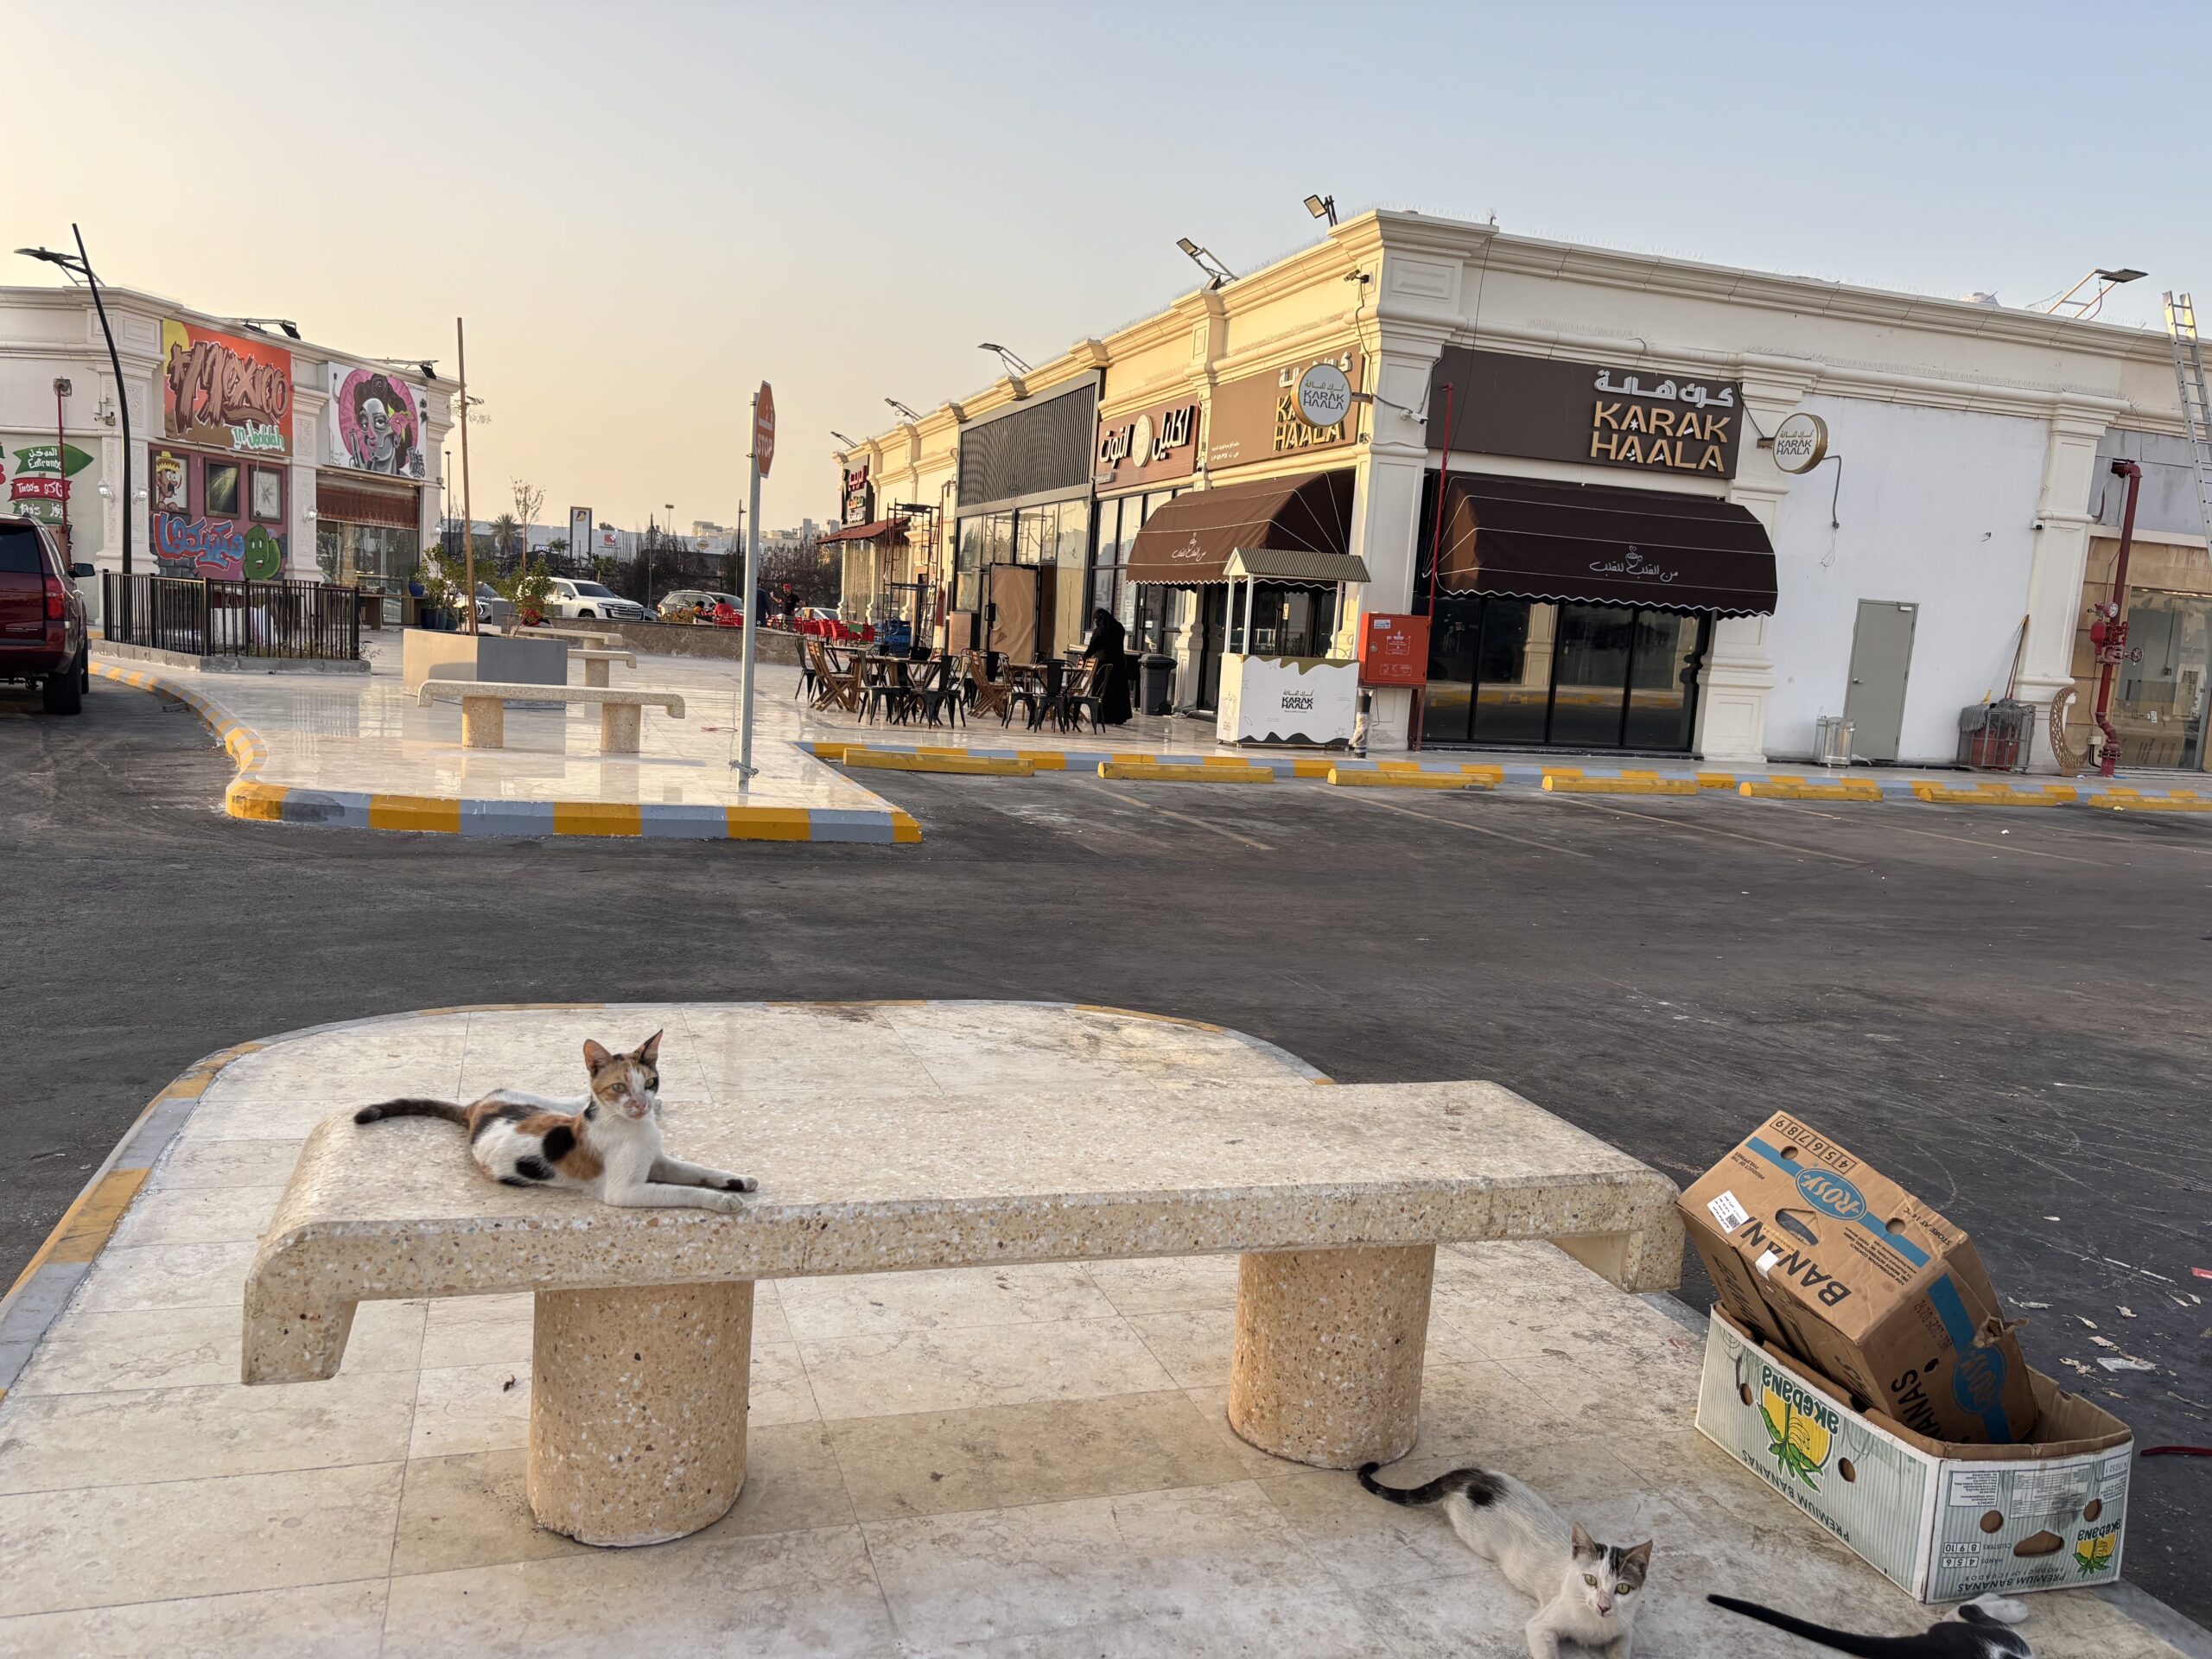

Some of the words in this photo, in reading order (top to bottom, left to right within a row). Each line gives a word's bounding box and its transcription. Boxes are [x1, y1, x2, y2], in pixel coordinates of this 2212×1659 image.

[167, 340, 289, 435] Mexico
[1593, 369, 1678, 401] هالة
[1303, 398, 1344, 410] HAALA
[1304, 390, 1344, 403] KARAK
[1678, 383, 1734, 409] كرك
[1593, 400, 1732, 443] KARAK
[1152, 404, 1193, 461] اكليل
[757, 433, 773, 458] STOP
[1099, 424, 1134, 469] التوت
[1590, 431, 1725, 473] HAALA
[1589, 561, 1624, 577] للقلب
[1626, 563, 1659, 580] القلب
[1660, 571, 1679, 582] من
[1787, 1127, 1798, 1135] 8
[1798, 1135, 1810, 1143] 7
[1735, 1152, 1759, 1170] PHILIPPINES
[1825, 1151, 1837, 1160] 5
[1745, 1164, 1765, 1180] PRODUCT
[1801, 1176, 1861, 1214] ROSY
[1929, 1228, 1952, 1246] STORE
[1740, 1217, 1852, 1307] BANAN
[1743, 1450, 1796, 1499] BANANAS
[1797, 1494, 1850, 1542] PREMIUM
[1957, 1578, 2012, 1592] BANANAS
[2017, 1573, 2066, 1585] PREMIUM
